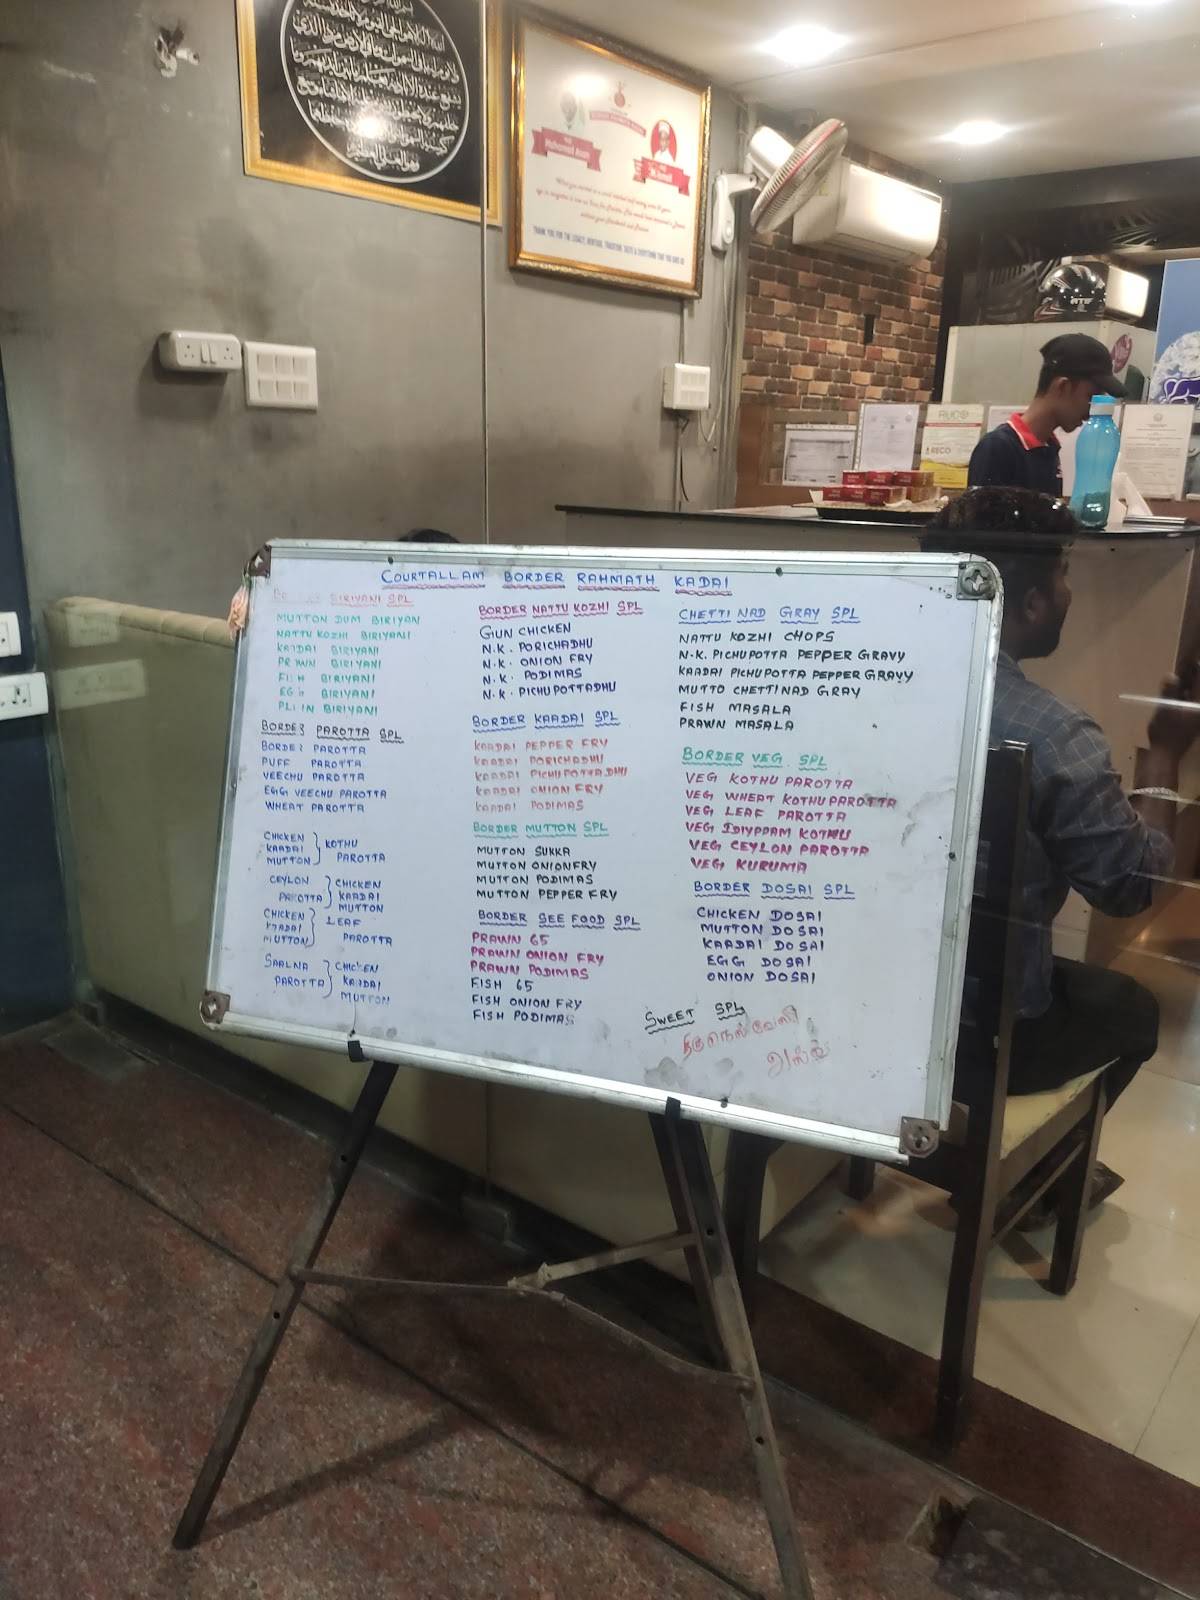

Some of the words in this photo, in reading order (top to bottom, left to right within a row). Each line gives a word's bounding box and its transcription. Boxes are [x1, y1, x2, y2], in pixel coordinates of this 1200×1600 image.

[381, 569, 485, 584] COURTALLAM
[504, 571, 564, 582] BORDER
[577, 572, 655, 584] RAHMATH
[674, 576, 729, 588] KADAI
[479, 605, 526, 615] BORDER
[533, 604, 568, 612] NATTU
[574, 601, 608, 612] KOZHI
[617, 601, 642, 611] SPL
[737, 608, 765, 618] NAD
[780, 607, 820, 620] GRAY
[831, 606, 859, 619] SPL
[277, 614, 327, 623] MUTTON
[519, 622, 571, 635] CHICKEN
[361, 631, 411, 640] BIRIYANI
[679, 633, 721, 643] NATTU
[730, 632, 771, 642] KOZHI
[784, 630, 835, 642] CHOPS
[519, 638, 593, 652] PORICHADHU
[521, 656, 562, 665] ONION
[570, 654, 592, 664] FRY
[798, 650, 852, 662] PEPPER
[858, 650, 905, 662] GRAVY
[331, 659, 381, 669] BIRIYANI
[321, 674, 375, 683] BIRIYANI
[525, 668, 582, 680] PODIMAS
[679, 666, 723, 676] KAADAI
[812, 670, 860, 680] PEPPER
[865, 670, 913, 682] GRAVY
[322, 689, 375, 699] BIRIYANI
[679, 684, 724, 694] MUTTO
[817, 686, 860, 698] GRAY
[323, 703, 378, 715] BIRIYANI
[680, 702, 714, 712] FISH
[729, 703, 791, 714] MASALA
[472, 714, 525, 727] BORDER
[535, 713, 584, 724] KAADAI
[595, 711, 618, 722] SPL
[680, 718, 726, 729] PRAWN
[736, 720, 794, 730] MASALA
[317, 725, 370, 737] PAROTTA
[380, 728, 402, 739] SPL
[314, 744, 366, 754] PAROTTA
[526, 739, 573, 751] PEPPER
[582, 738, 608, 747] FRY
[262, 757, 289, 767] PUFF
[311, 759, 361, 768] PAROTTA
[683, 747, 744, 762] BORDER
[753, 753, 783, 764] VEG
[799, 755, 826, 766] SPL
[263, 771, 303, 781] VEECHU
[313, 772, 364, 782] PAROTTA
[686, 772, 717, 784] VEG
[729, 773, 779, 785] KOTHU
[785, 776, 853, 790] PAROTTA
[264, 785, 288, 796] EGG
[295, 789, 332, 798] VEECHU
[340, 790, 387, 799] PAROTTA
[531, 785, 570, 794] ONION
[575, 784, 603, 794] FRY
[531, 800, 583, 811] PODIMAS
[685, 790, 714, 800] VEG
[725, 792, 775, 803] WHEAT
[783, 793, 826, 805] KOTHU
[829, 796, 897, 808] PAROTTA
[265, 801, 303, 811] WHEAT
[312, 803, 364, 813] PAROTTA
[685, 805, 714, 817] VEG
[725, 806, 764, 818] LEAF
[778, 810, 846, 822] PAROTTA
[473, 822, 517, 832] BORDER
[526, 824, 576, 832] MUTTON
[584, 822, 608, 832] SPL
[685, 822, 714, 833] VEG
[799, 828, 851, 840] KOTHU
[264, 831, 304, 841] CHICKEN
[325, 839, 358, 848] KOTHU
[477, 846, 525, 855] MUTTON
[535, 846, 570, 856] SUKKA
[689, 839, 721, 850] VEG
[730, 840, 792, 855] CEYLON
[800, 843, 869, 856] PAROTTA
[266, 856, 311, 865] MUTTON
[337, 852, 386, 863] PAROTTA
[690, 857, 724, 871] VEG
[736, 858, 807, 873] KURUMA
[477, 861, 526, 870] MUTTON
[270, 875, 309, 886] CEYLON
[336, 879, 381, 889] CHICKEN
[476, 875, 528, 884] MUTTON
[537, 875, 593, 884] PODIMAS
[694, 881, 750, 892] BORDER
[762, 884, 812, 894] DOSAI
[824, 884, 855, 894] SPL
[339, 890, 379, 901] KAADAI
[476, 890, 529, 899] MUTTON
[538, 889, 583, 899] PEPPER
[589, 889, 617, 901] FRY
[264, 908, 304, 921] CHICKEN
[339, 904, 383, 913] MUTTON
[697, 907, 760, 920] CHICKEN
[770, 910, 821, 922] DOSAI
[326, 916, 361, 925] LEAF
[478, 910, 527, 921] BORDER
[539, 913, 564, 924] SEE
[572, 915, 605, 924] FOOD
[614, 916, 640, 926] SPL
[701, 923, 763, 934] MUTTON
[772, 926, 823, 936] DOSAI
[343, 933, 392, 946] PAROTTA
[472, 932, 521, 944] PRAWN
[530, 934, 549, 945] 65
[703, 938, 762, 950] KAADAI
[774, 940, 824, 951] DOSAI
[471, 946, 520, 958] PRAWN
[526, 950, 568, 962] ONION
[577, 953, 604, 966] FRY
[707, 955, 744, 967] EGG
[761, 956, 810, 968] DOSAI
[470, 960, 519, 975] PRAWN
[529, 964, 589, 979] PODIMAS
[275, 975, 324, 987] PAROTTA
[707, 972, 754, 982] ONION
[765, 971, 815, 984] DOSAI
[471, 977, 501, 989] FISH
[517, 980, 533, 992] 65
[472, 994, 500, 1005] FISH
[510, 998, 549, 1008] ONION
[556, 999, 582, 1010] FRY
[473, 1010, 503, 1021] FISH
[645, 1008, 694, 1027] SWEET
